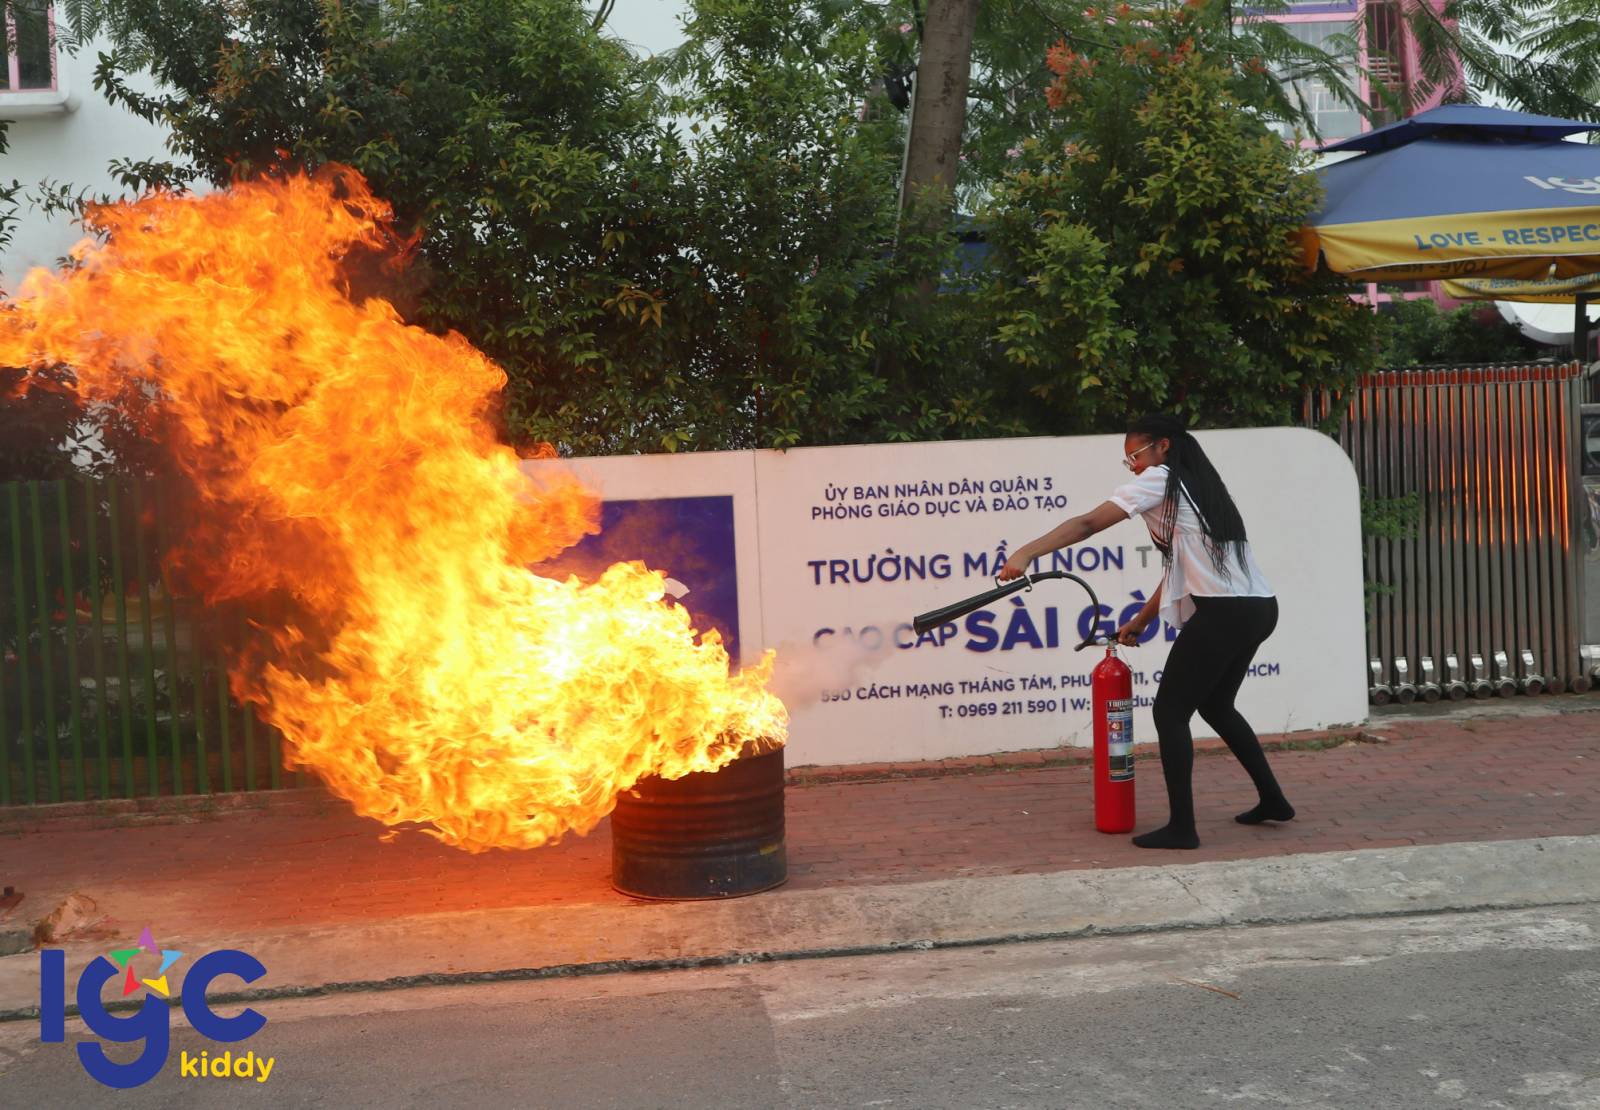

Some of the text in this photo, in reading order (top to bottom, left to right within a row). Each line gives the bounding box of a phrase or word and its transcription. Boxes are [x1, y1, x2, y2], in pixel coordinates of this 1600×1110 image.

[1415, 231, 1483, 250] LOVE
[1503, 224, 1600, 246] RESPEC
[854, 484, 888, 500] BAN
[895, 479, 943, 497] NHÂN
[949, 478, 984, 495] DÂN
[989, 475, 1038, 494] QUẬN
[1043, 477, 1053, 490] 3
[811, 492, 1067, 520] PHÒNG GIÁO DỤC VÀ ĐÀO TẠO
[807, 548, 951, 585] TRƯỜNG
[1052, 545, 1123, 572] NON
[965, 596, 1059, 653] SÀI
[856, 683, 900, 700] CÁCH
[906, 682, 954, 699] MẠNG
[959, 677, 1015, 695] THÁNG
[1019, 675, 1056, 691] TÁM,
[939, 706, 952, 719] T:
[957, 704, 997, 717] 0969
[1002, 702, 1023, 715] 211
[1028, 700, 1057, 713] 590
[1070, 698, 1090, 711] W:
